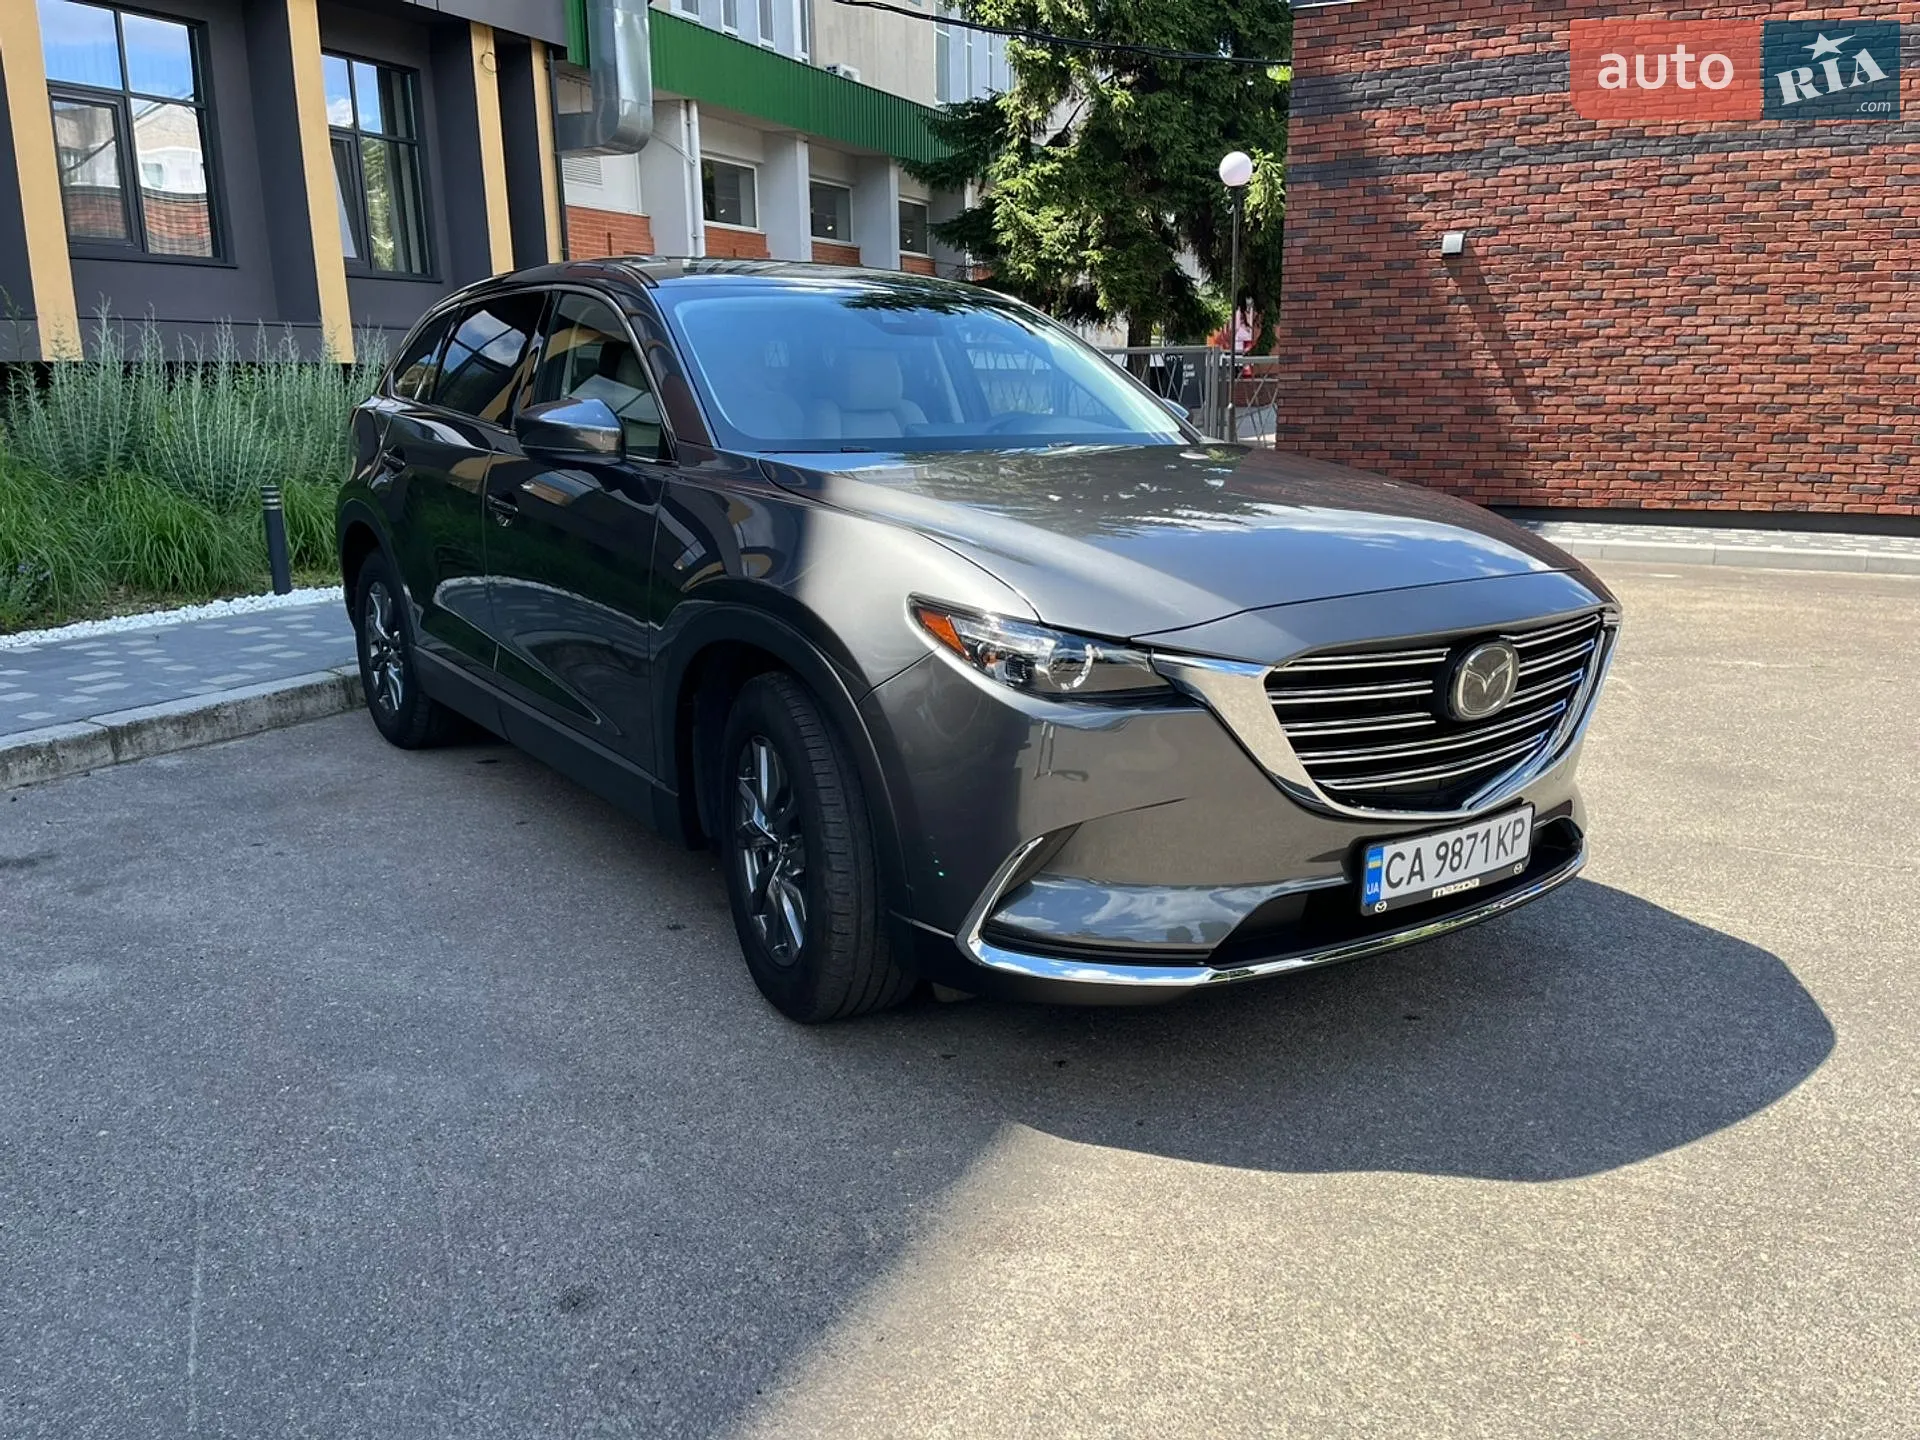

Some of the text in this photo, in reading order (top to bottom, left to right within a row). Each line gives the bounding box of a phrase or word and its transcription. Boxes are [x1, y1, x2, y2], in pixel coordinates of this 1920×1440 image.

[1385, 818, 1526, 889] CA 9871 KP
[1366, 882, 1380, 895] UA
